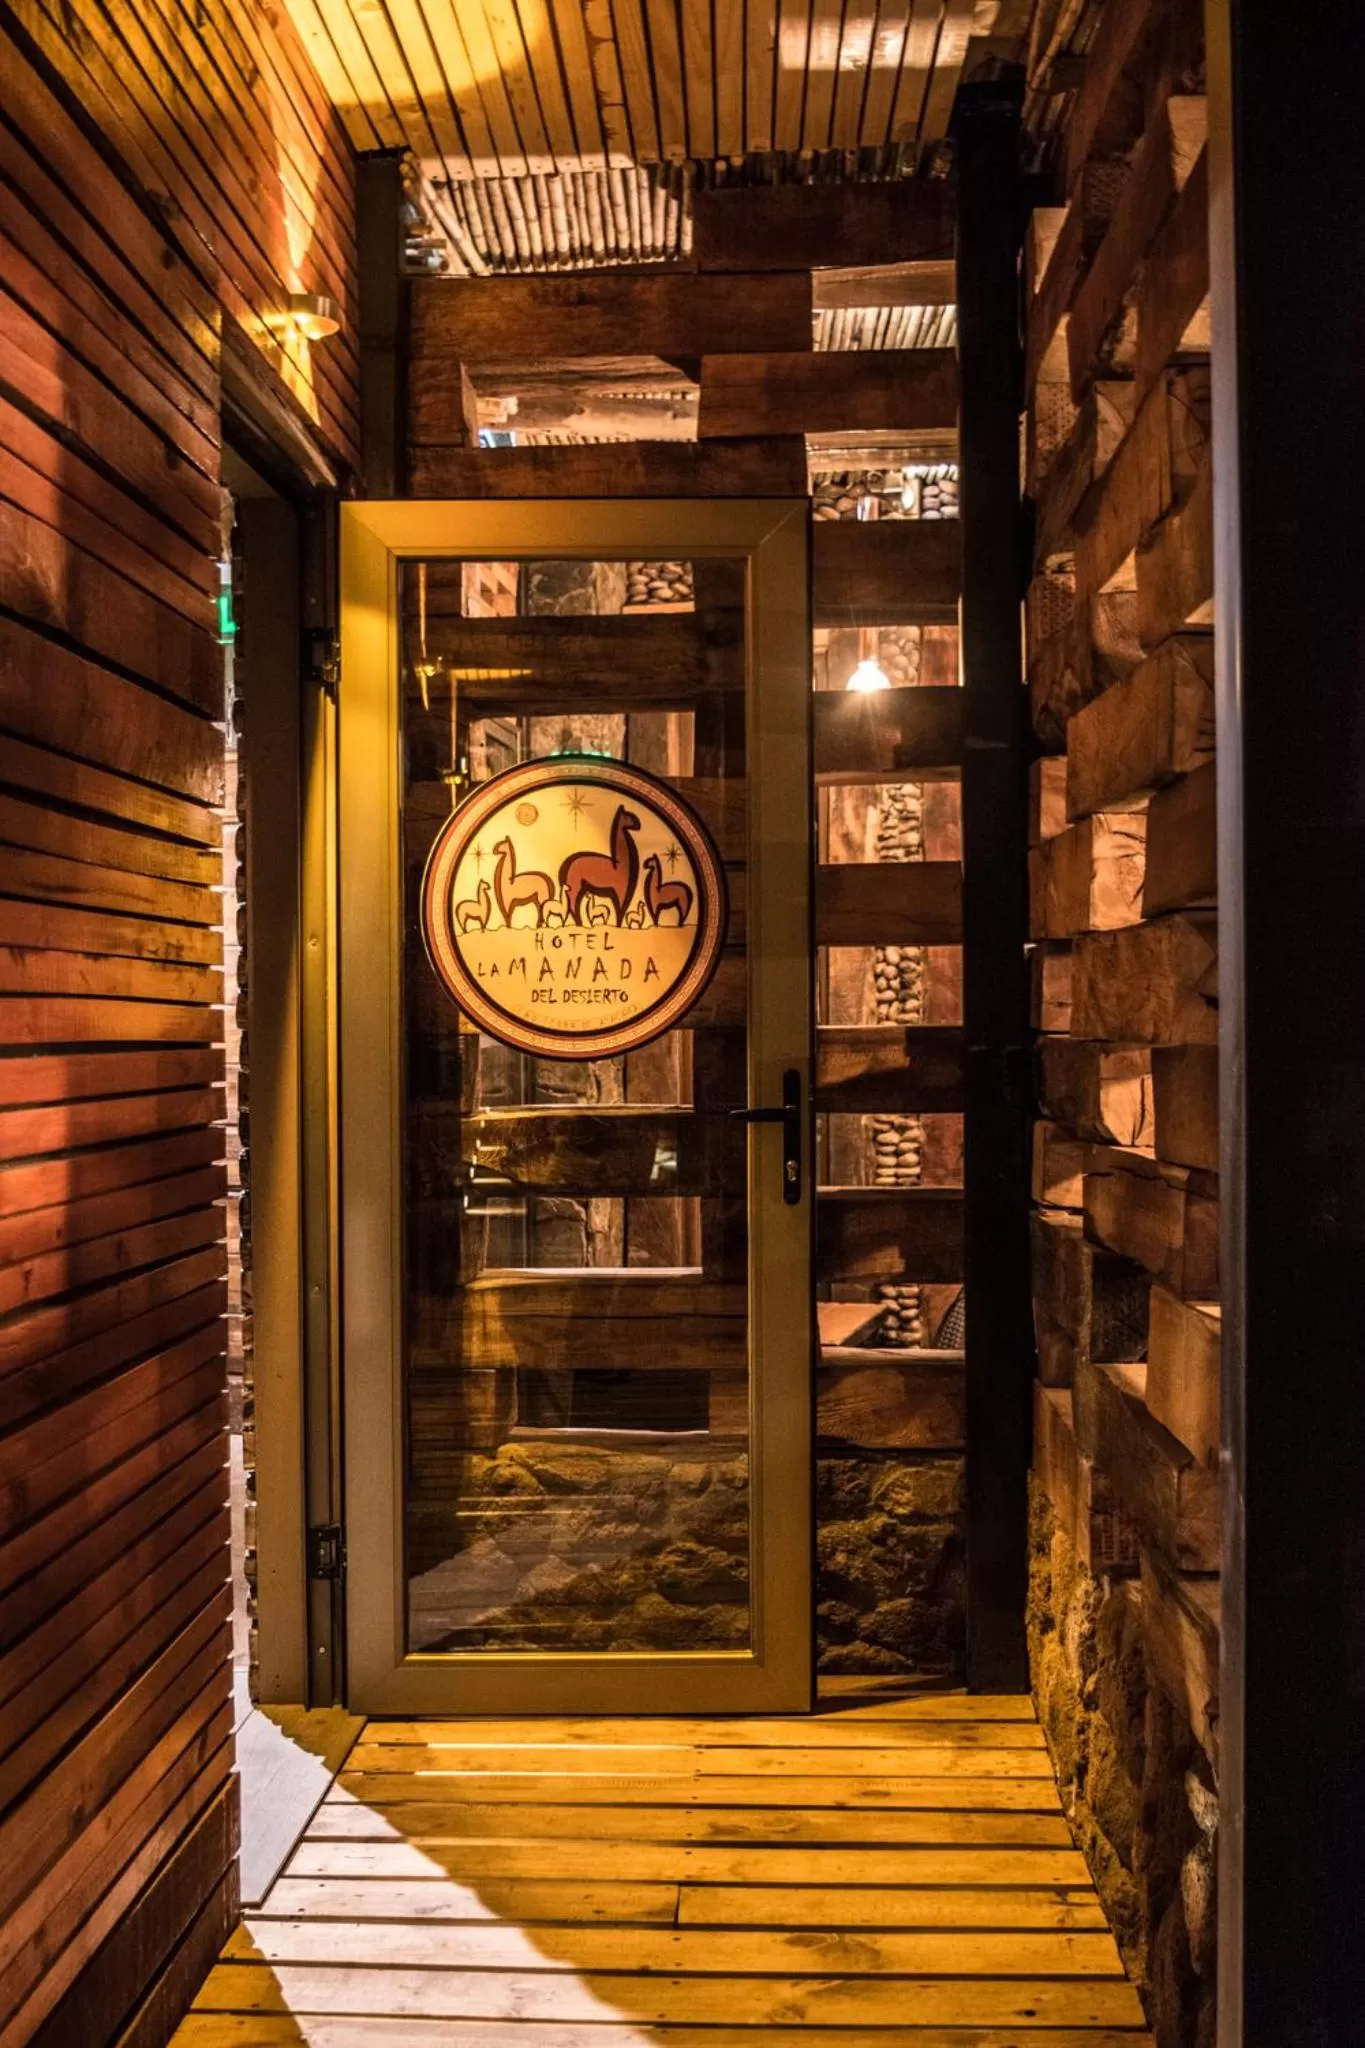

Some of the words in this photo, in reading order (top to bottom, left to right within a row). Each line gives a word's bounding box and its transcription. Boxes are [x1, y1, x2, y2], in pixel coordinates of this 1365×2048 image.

[535, 931, 615, 952] HOTEL
[477, 962, 500, 977] LA
[508, 956, 660, 982] MANADA
[531, 988, 557, 1004] DEL
[562, 988, 629, 1004] DESIERTO
